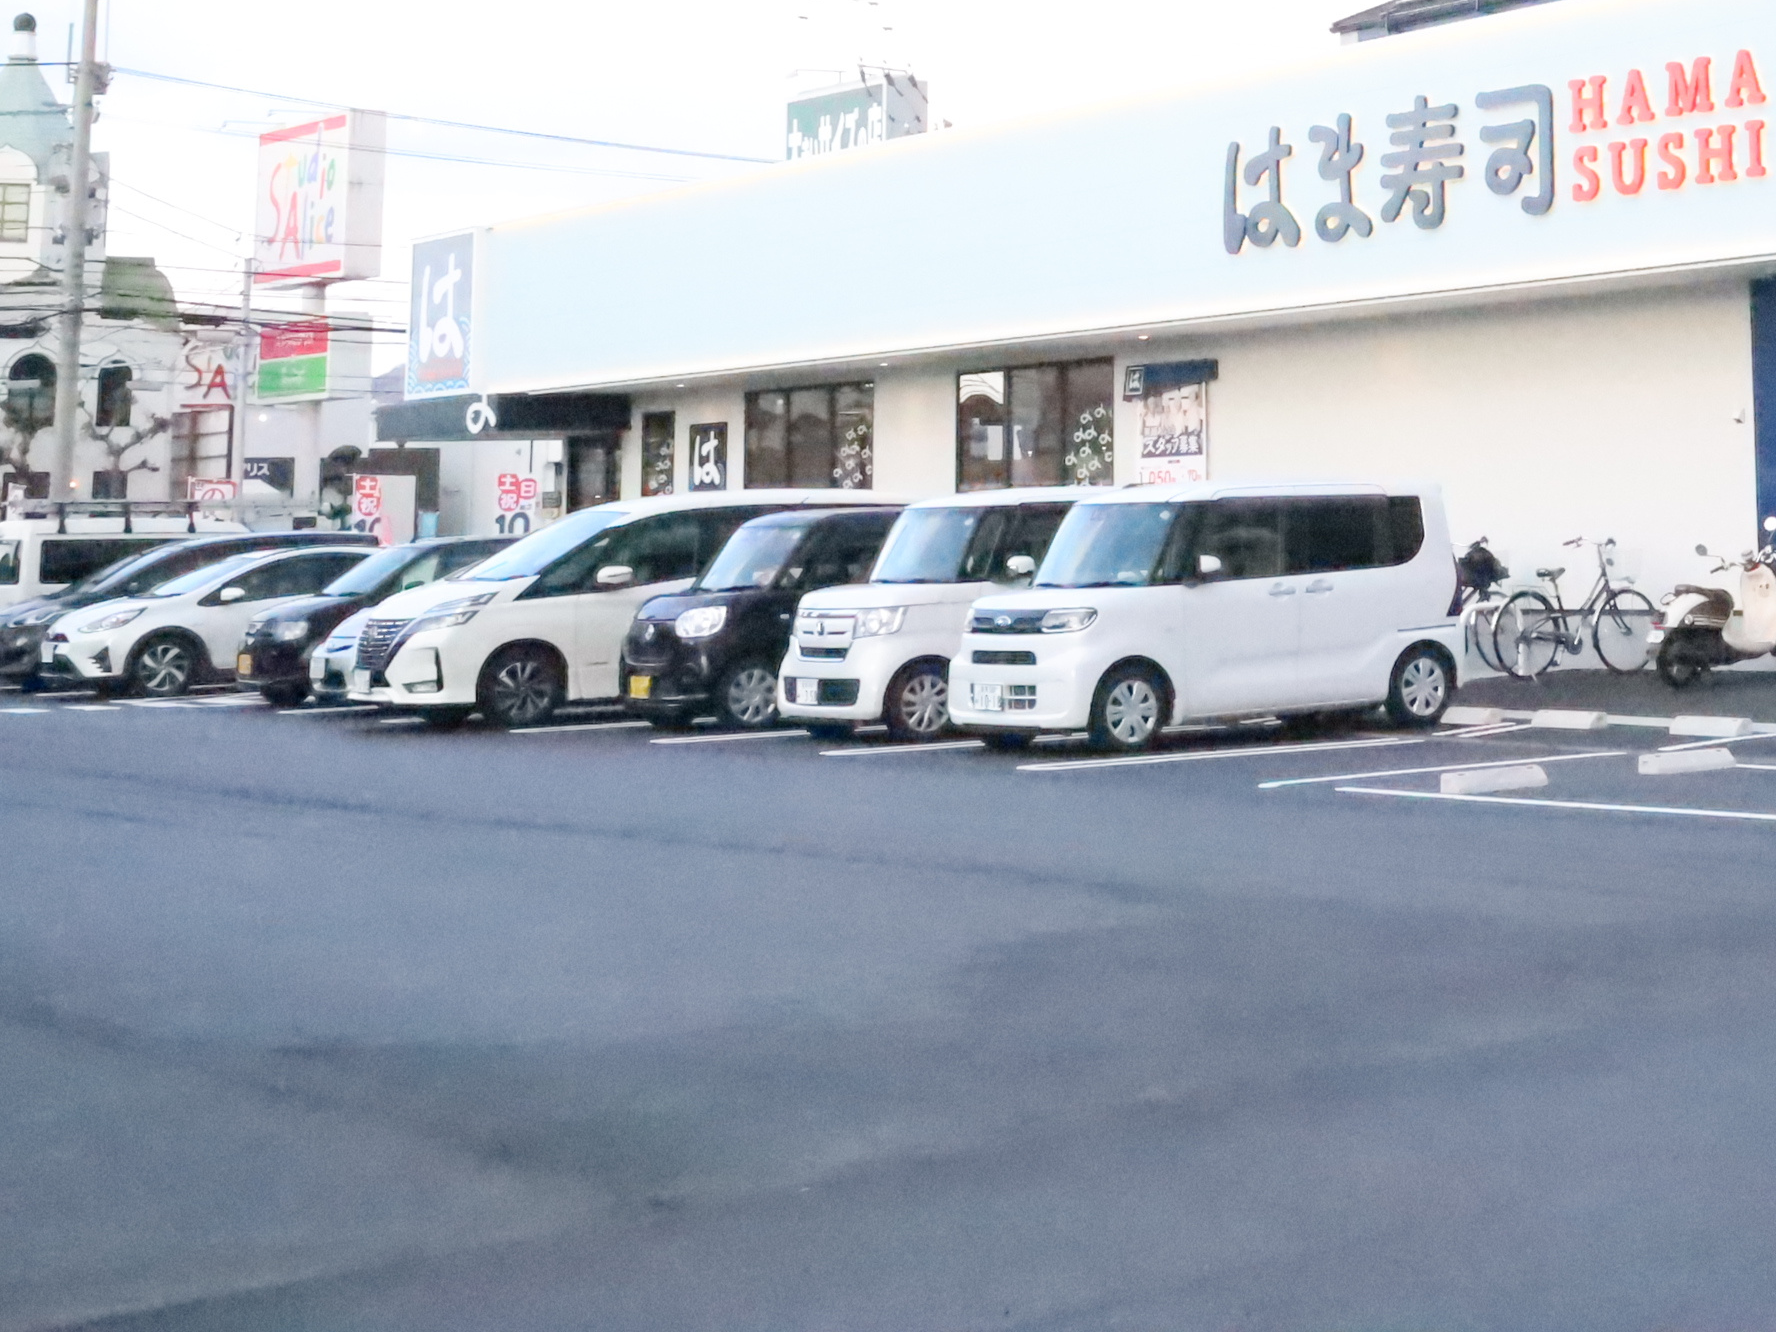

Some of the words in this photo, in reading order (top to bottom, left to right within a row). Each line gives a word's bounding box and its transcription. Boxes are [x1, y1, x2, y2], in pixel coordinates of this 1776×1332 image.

[1568, 49, 1767, 133] HAMA
[1223, 84, 1554, 255] はま寿司
[1572, 120, 1767, 202] SUSHI
[419, 253, 465, 364] は
[693, 430, 719, 486] は
